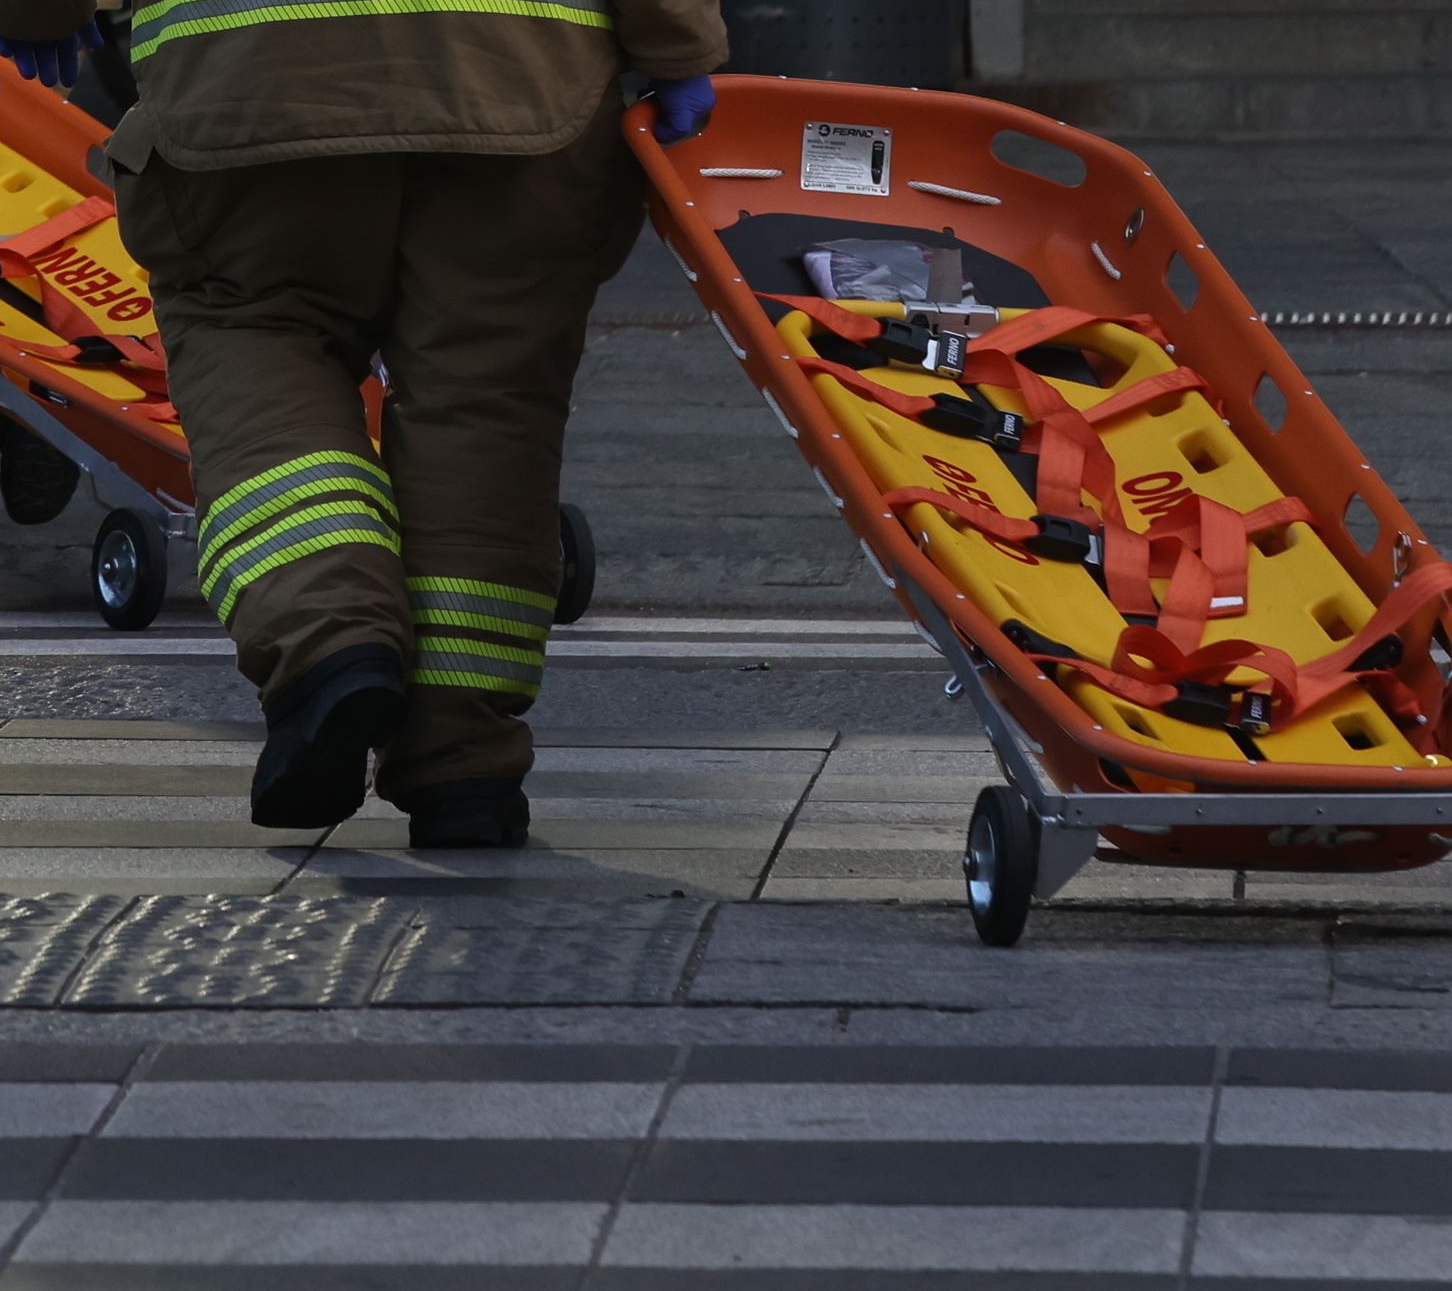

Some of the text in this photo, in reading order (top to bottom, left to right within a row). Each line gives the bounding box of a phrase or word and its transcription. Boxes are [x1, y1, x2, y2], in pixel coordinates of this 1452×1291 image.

[832, 127, 874, 138] FERNO
[31, 246, 137, 308] FERN
[946, 337, 960, 366] FERNO
[1004, 414, 1016, 434] FERNO
